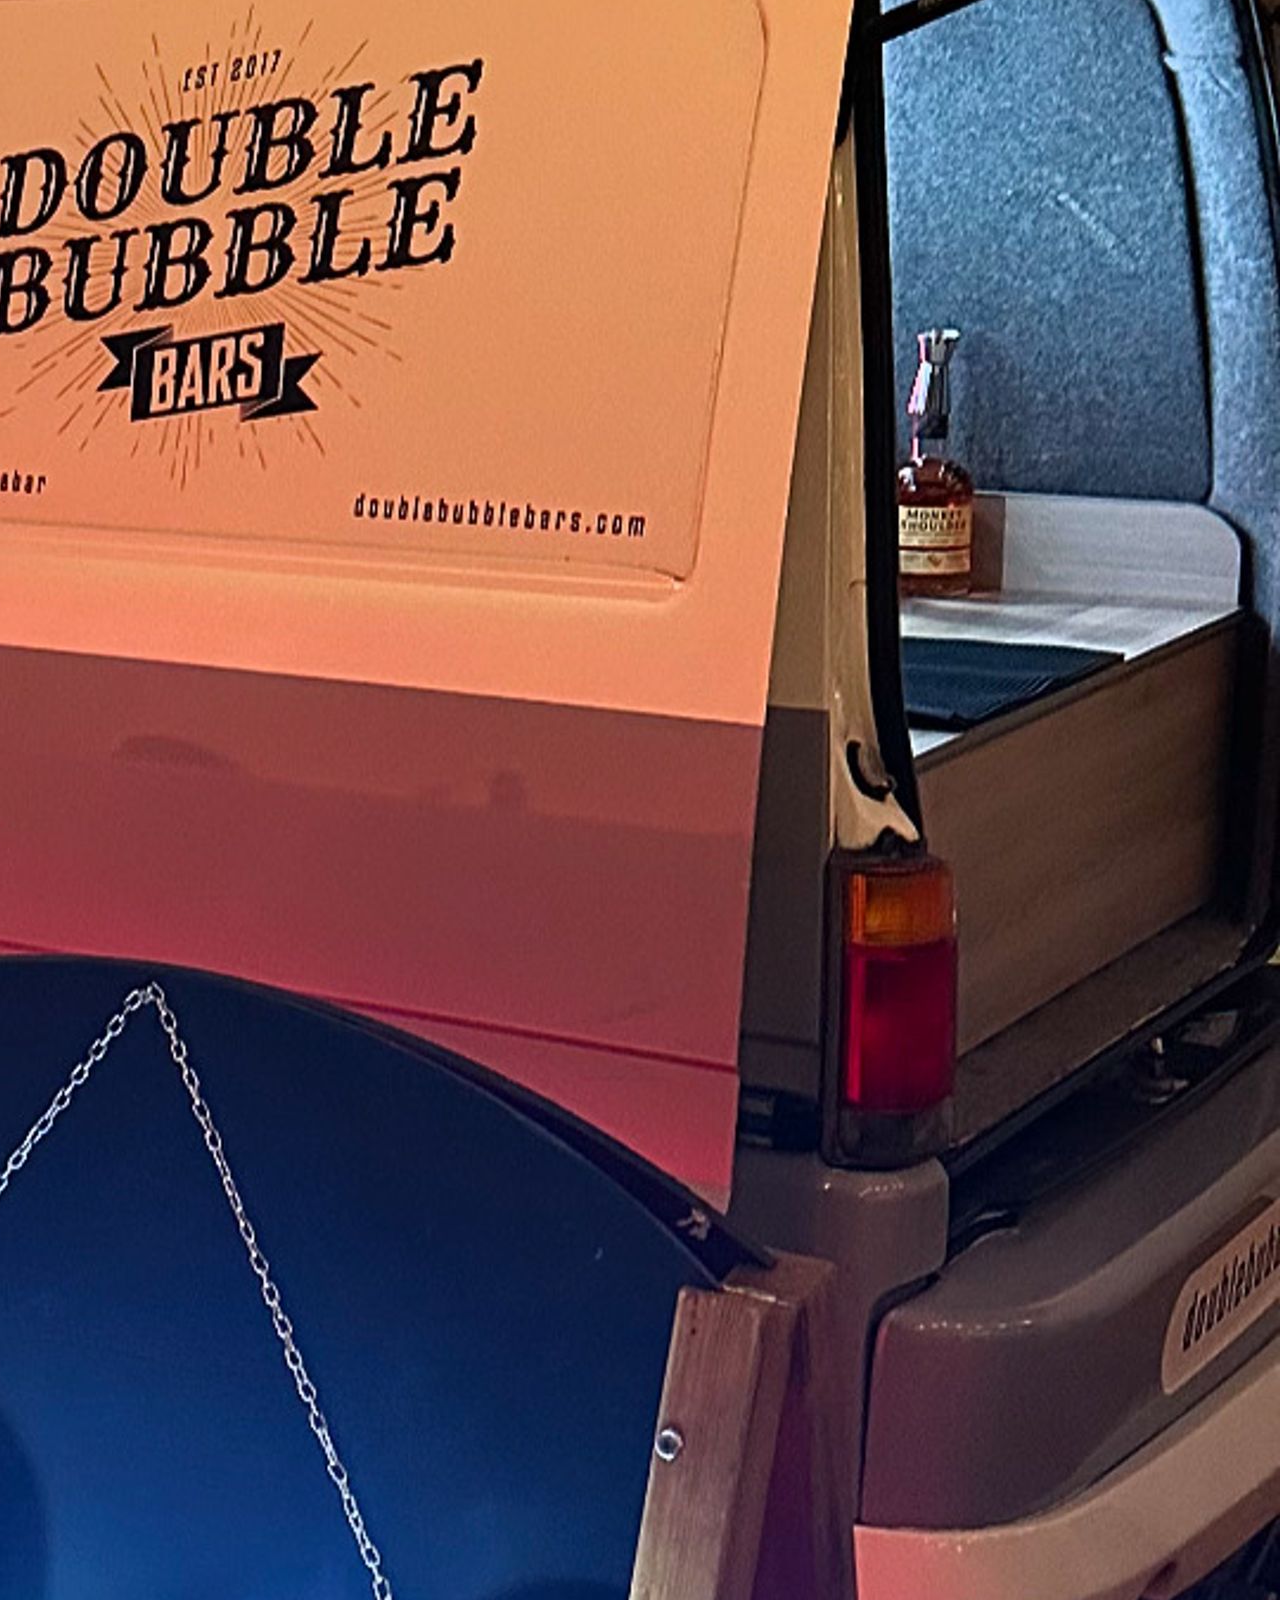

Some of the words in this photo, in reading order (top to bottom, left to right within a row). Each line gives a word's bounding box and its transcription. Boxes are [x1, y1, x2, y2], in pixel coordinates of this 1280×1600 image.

[183, 62, 219, 92] EST
[230, 48, 282, 82] 2017
[149, 331, 266, 414] BARS
[352, 493, 646, 538] doublebubblebars.com
